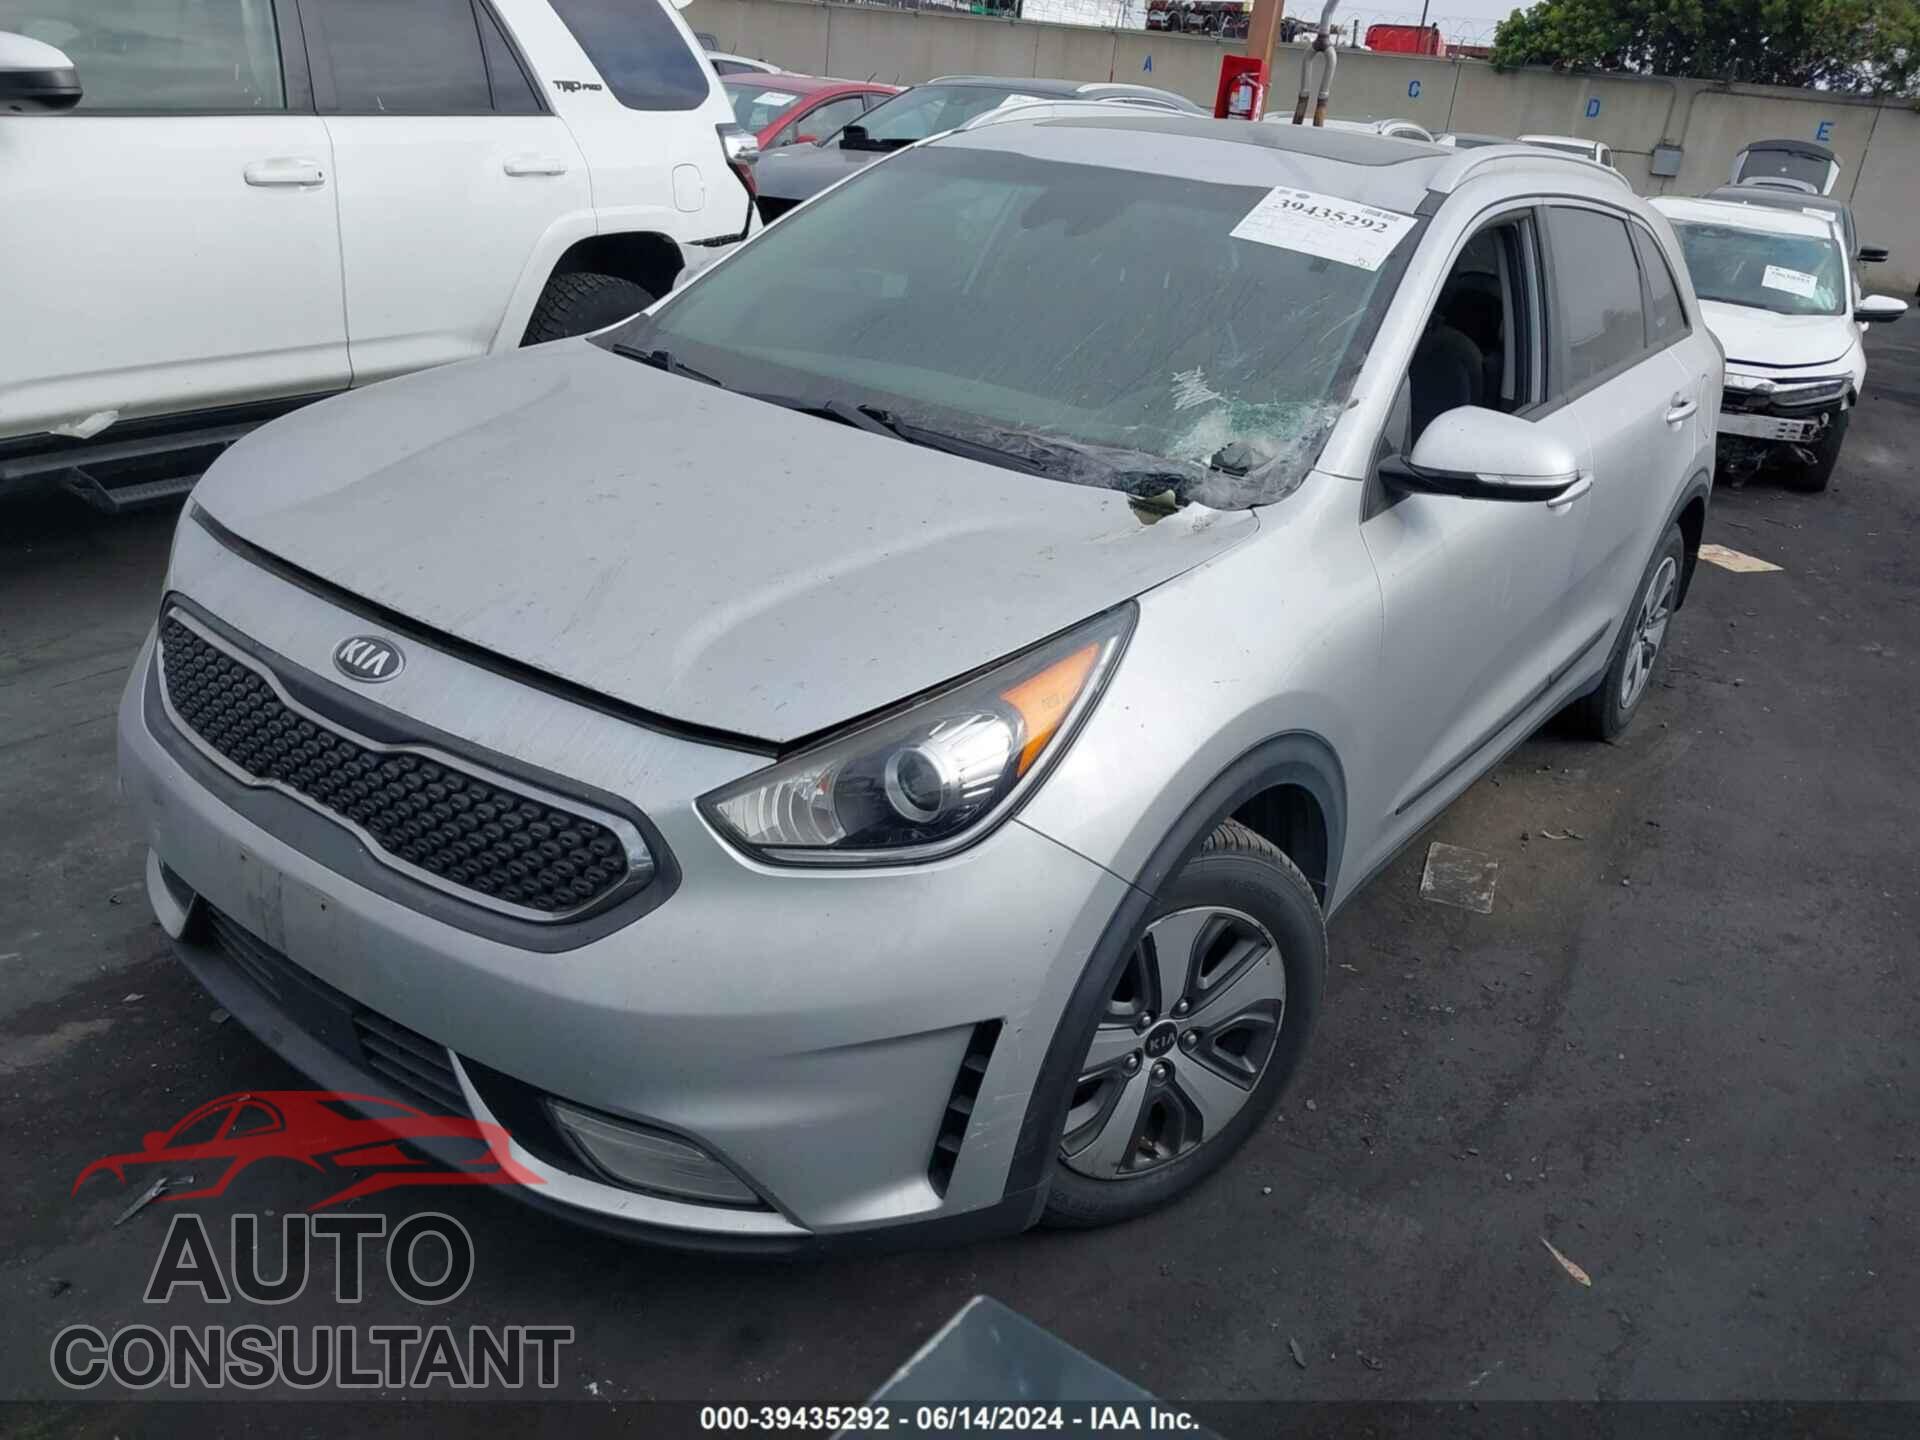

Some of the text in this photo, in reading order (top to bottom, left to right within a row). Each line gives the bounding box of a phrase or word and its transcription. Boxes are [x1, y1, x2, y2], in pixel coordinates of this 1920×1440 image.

[1143, 55, 1152, 72] A
[1408, 80, 1421, 98] C
[1586, 98, 1601, 118] D
[1816, 121, 1834, 141] E
[1273, 199, 1388, 233] 39435292
[339, 639, 390, 676] KIA
[1151, 1031, 1176, 1049] KIA
